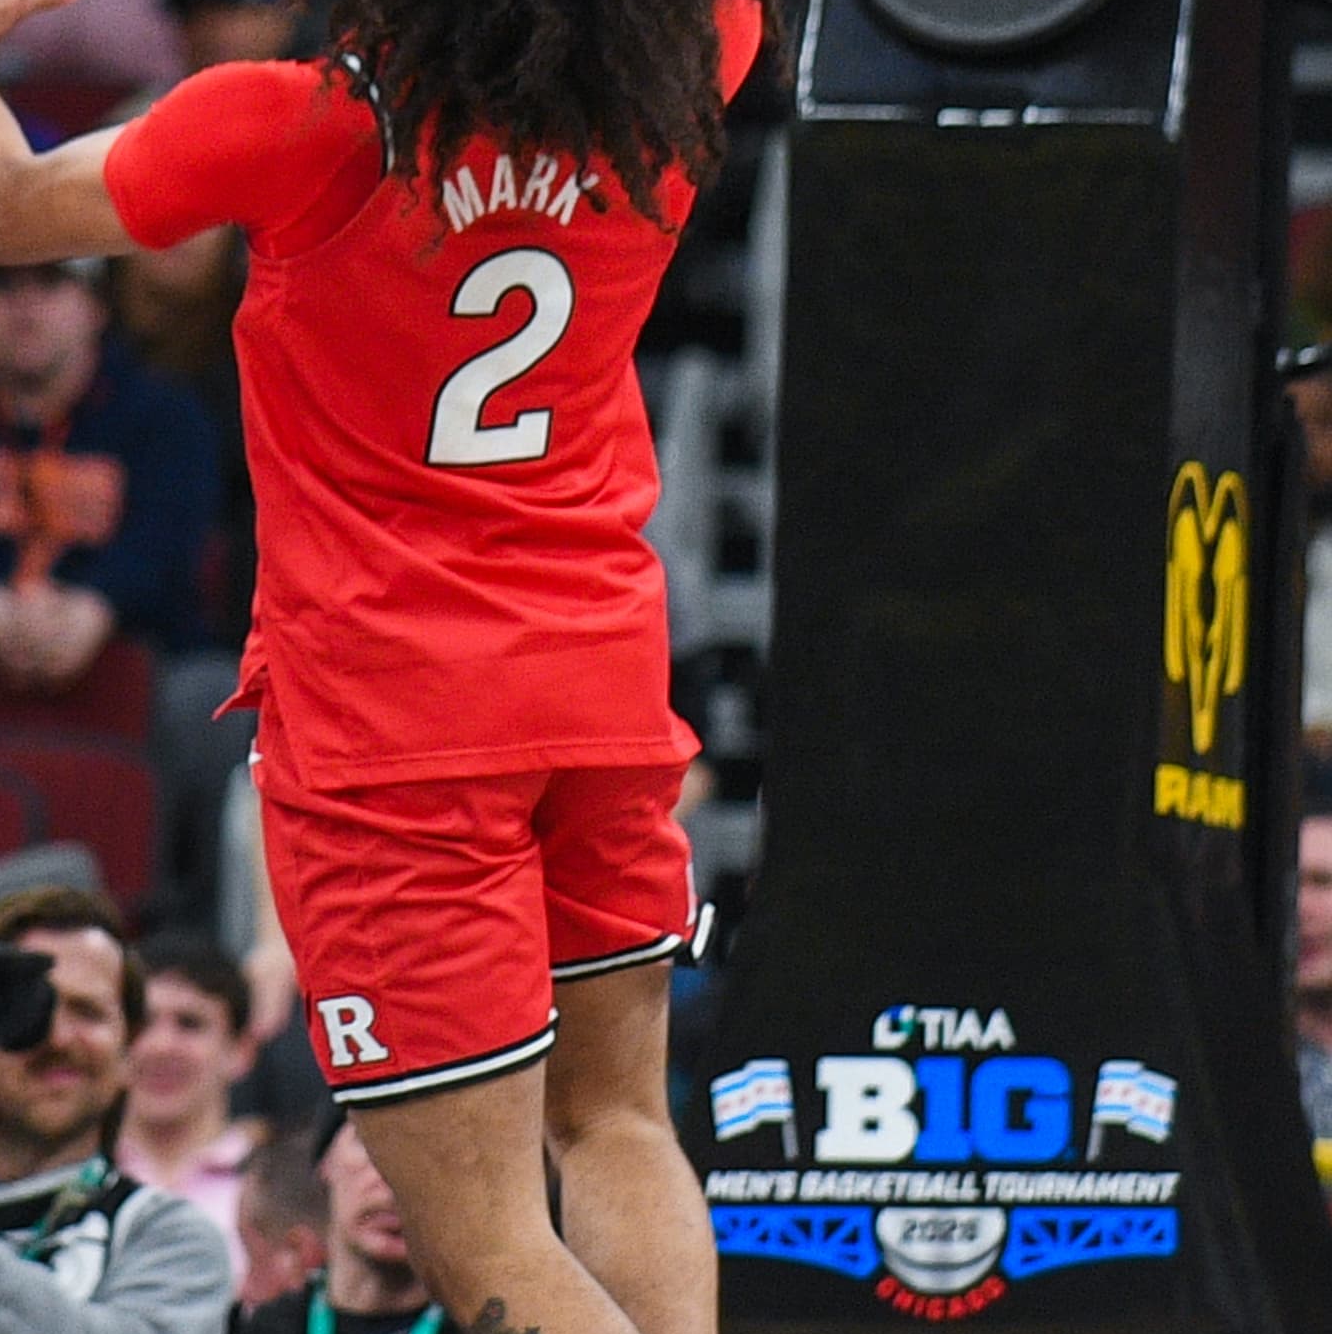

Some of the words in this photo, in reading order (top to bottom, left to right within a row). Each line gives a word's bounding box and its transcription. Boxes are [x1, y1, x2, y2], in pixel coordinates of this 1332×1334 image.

[441, 154, 600, 234] MARK
[426, 244, 577, 468] 2
[1153, 764, 1246, 830] RAM
[316, 994, 389, 1068] R
[917, 1007, 1017, 1050] TIAA
[704, 1170, 799, 1202] MEN'S
[799, 1170, 981, 1202] BASKETBALL
[982, 1170, 1181, 1203] TOURNAMENT
[875, 1274, 1008, 1323] CHICAGO
